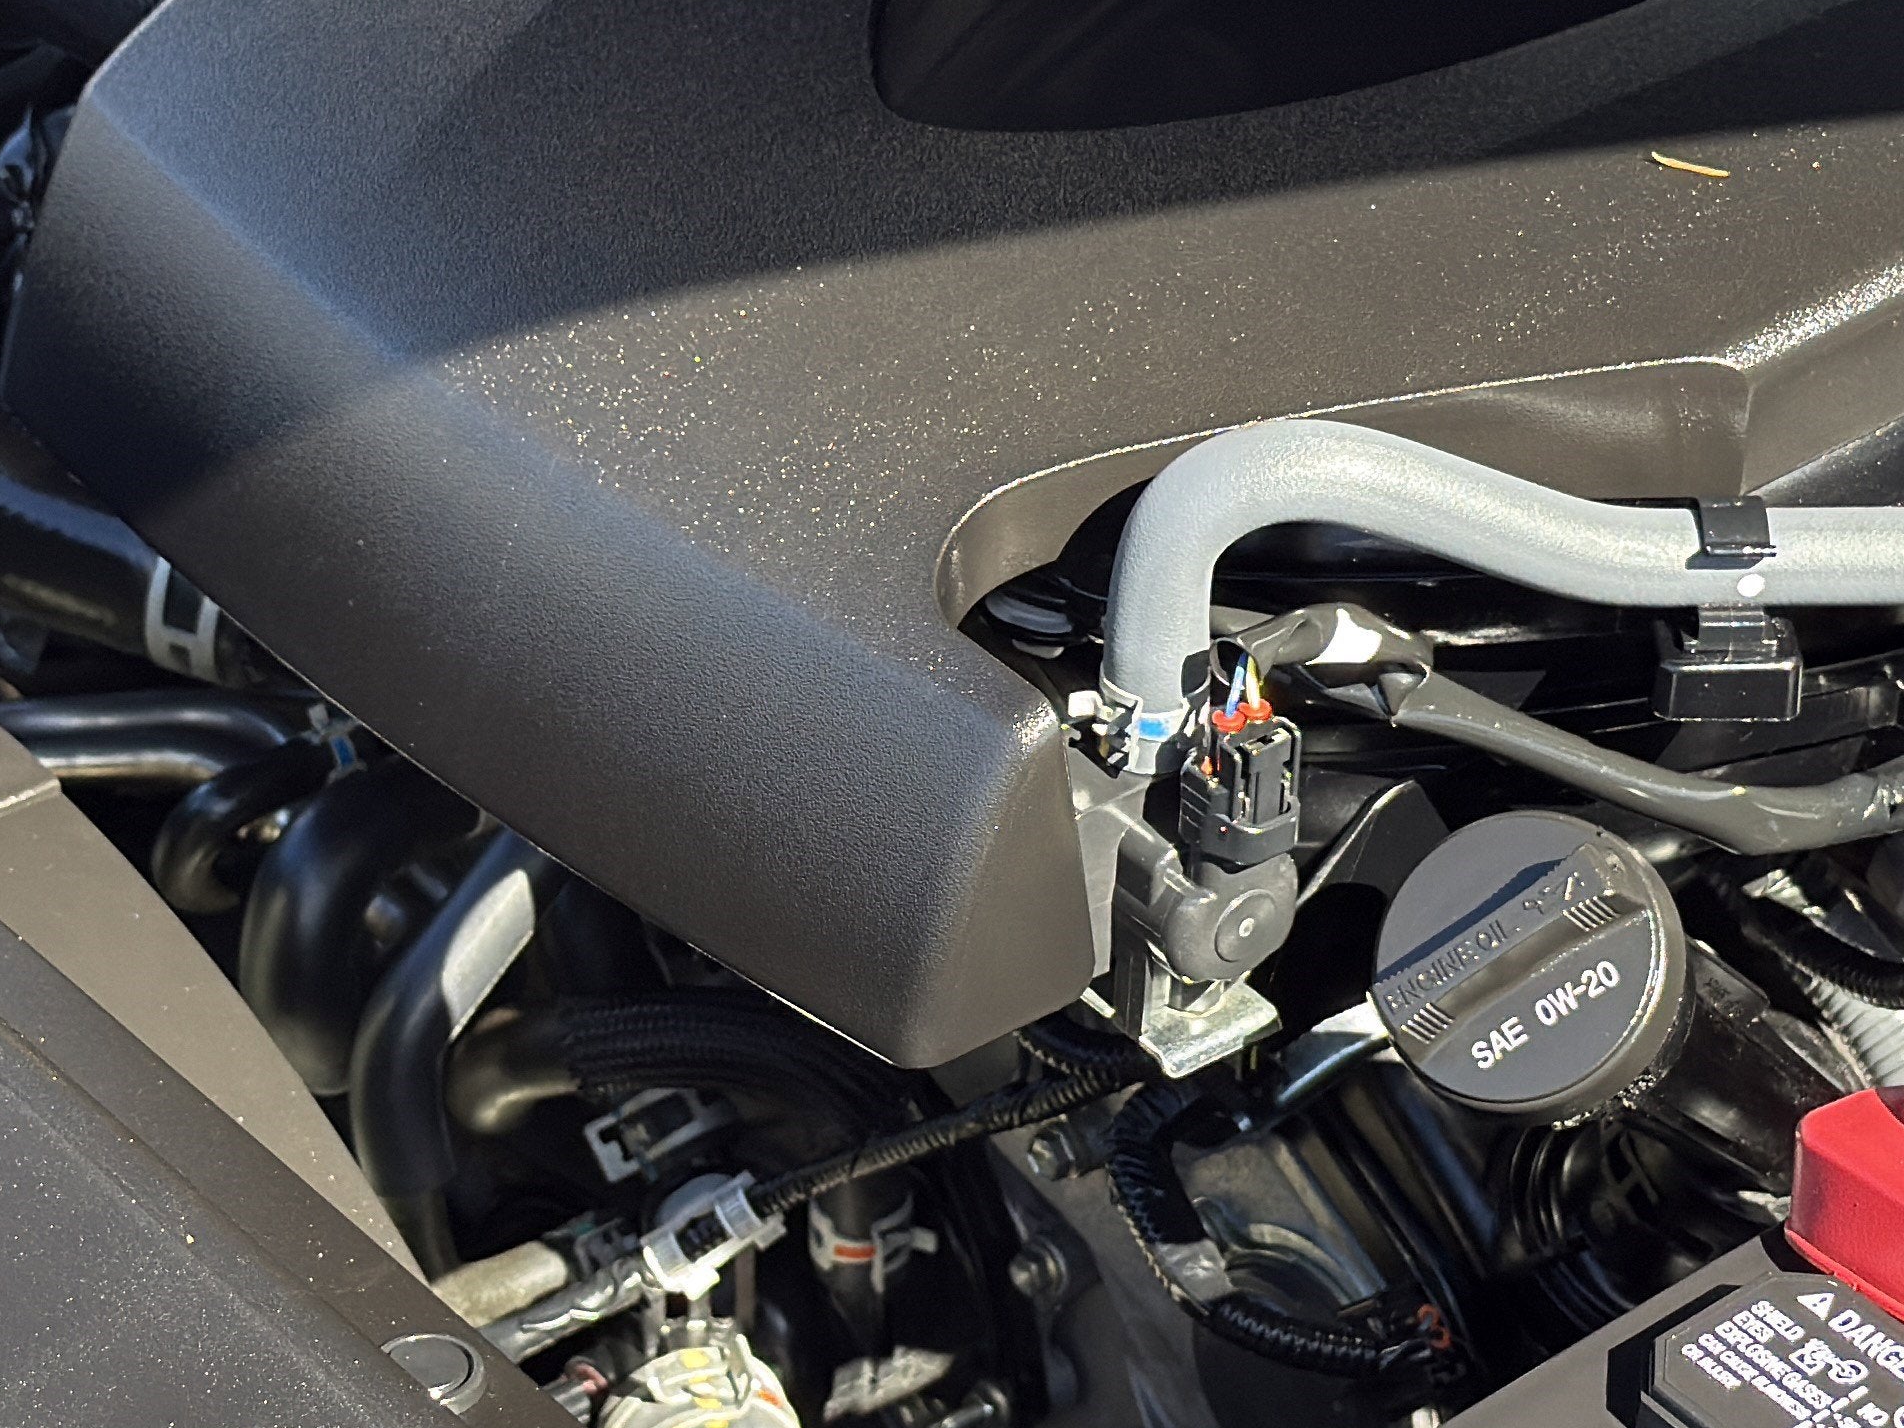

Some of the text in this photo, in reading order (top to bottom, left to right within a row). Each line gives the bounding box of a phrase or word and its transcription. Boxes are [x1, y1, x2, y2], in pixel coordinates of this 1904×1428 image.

[1383, 919, 1508, 1014] ENGINE OIL
[1471, 960, 1620, 1069] SAE 0W-20
